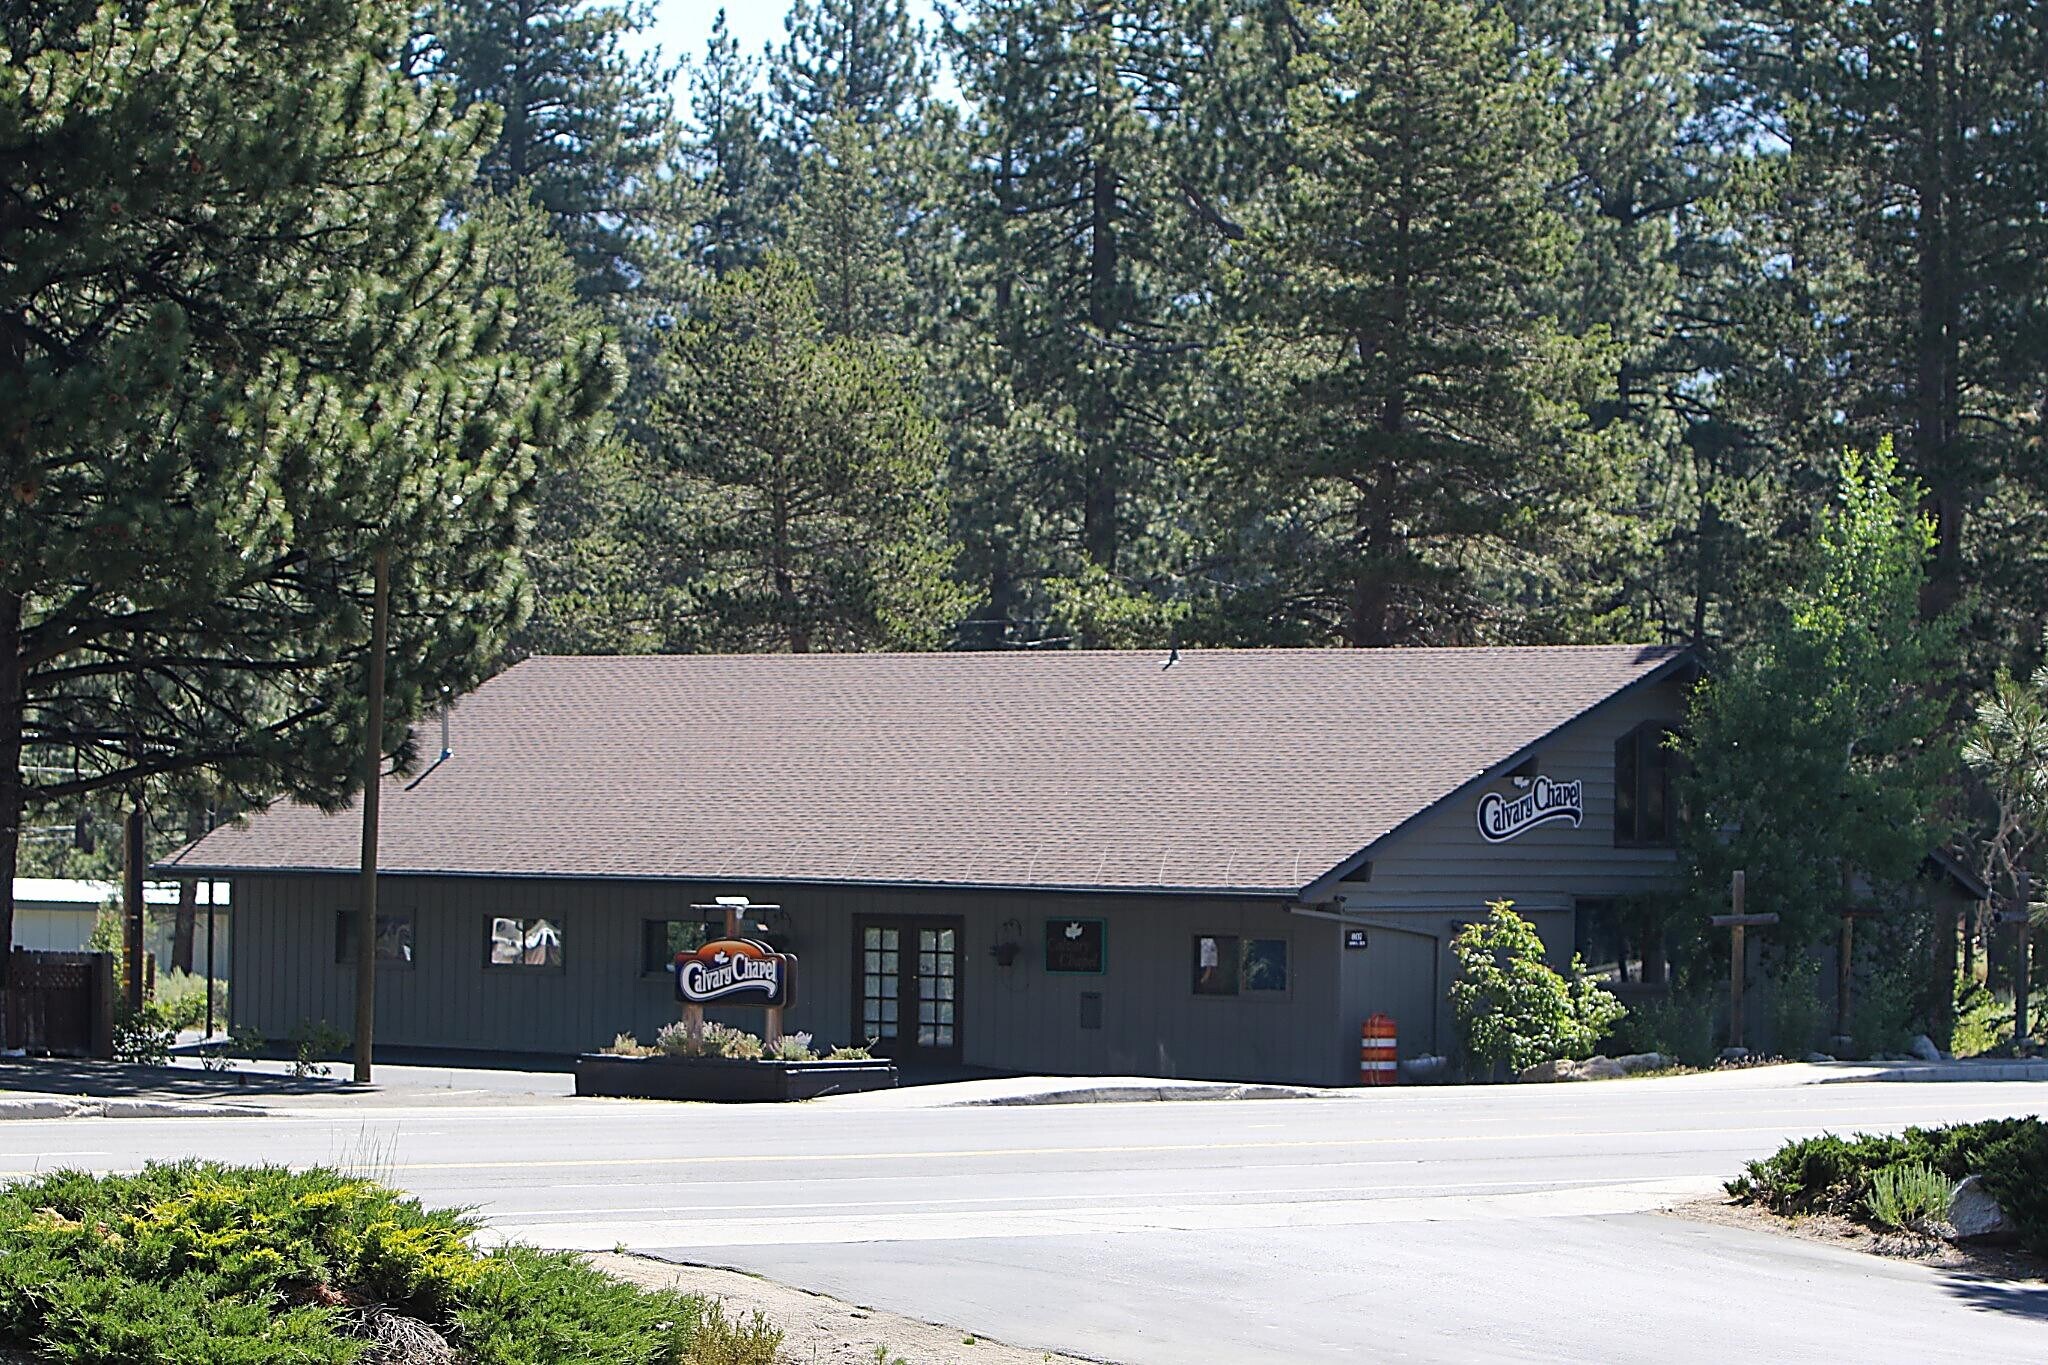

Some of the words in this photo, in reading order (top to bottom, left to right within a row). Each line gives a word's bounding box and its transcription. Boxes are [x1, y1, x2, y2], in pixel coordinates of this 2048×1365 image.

[1479, 793, 1533, 840] Calvary
[1533, 777, 1581, 811] Chapel
[682, 961, 732, 998] Calvary
[732, 953, 777, 982] Chapel
